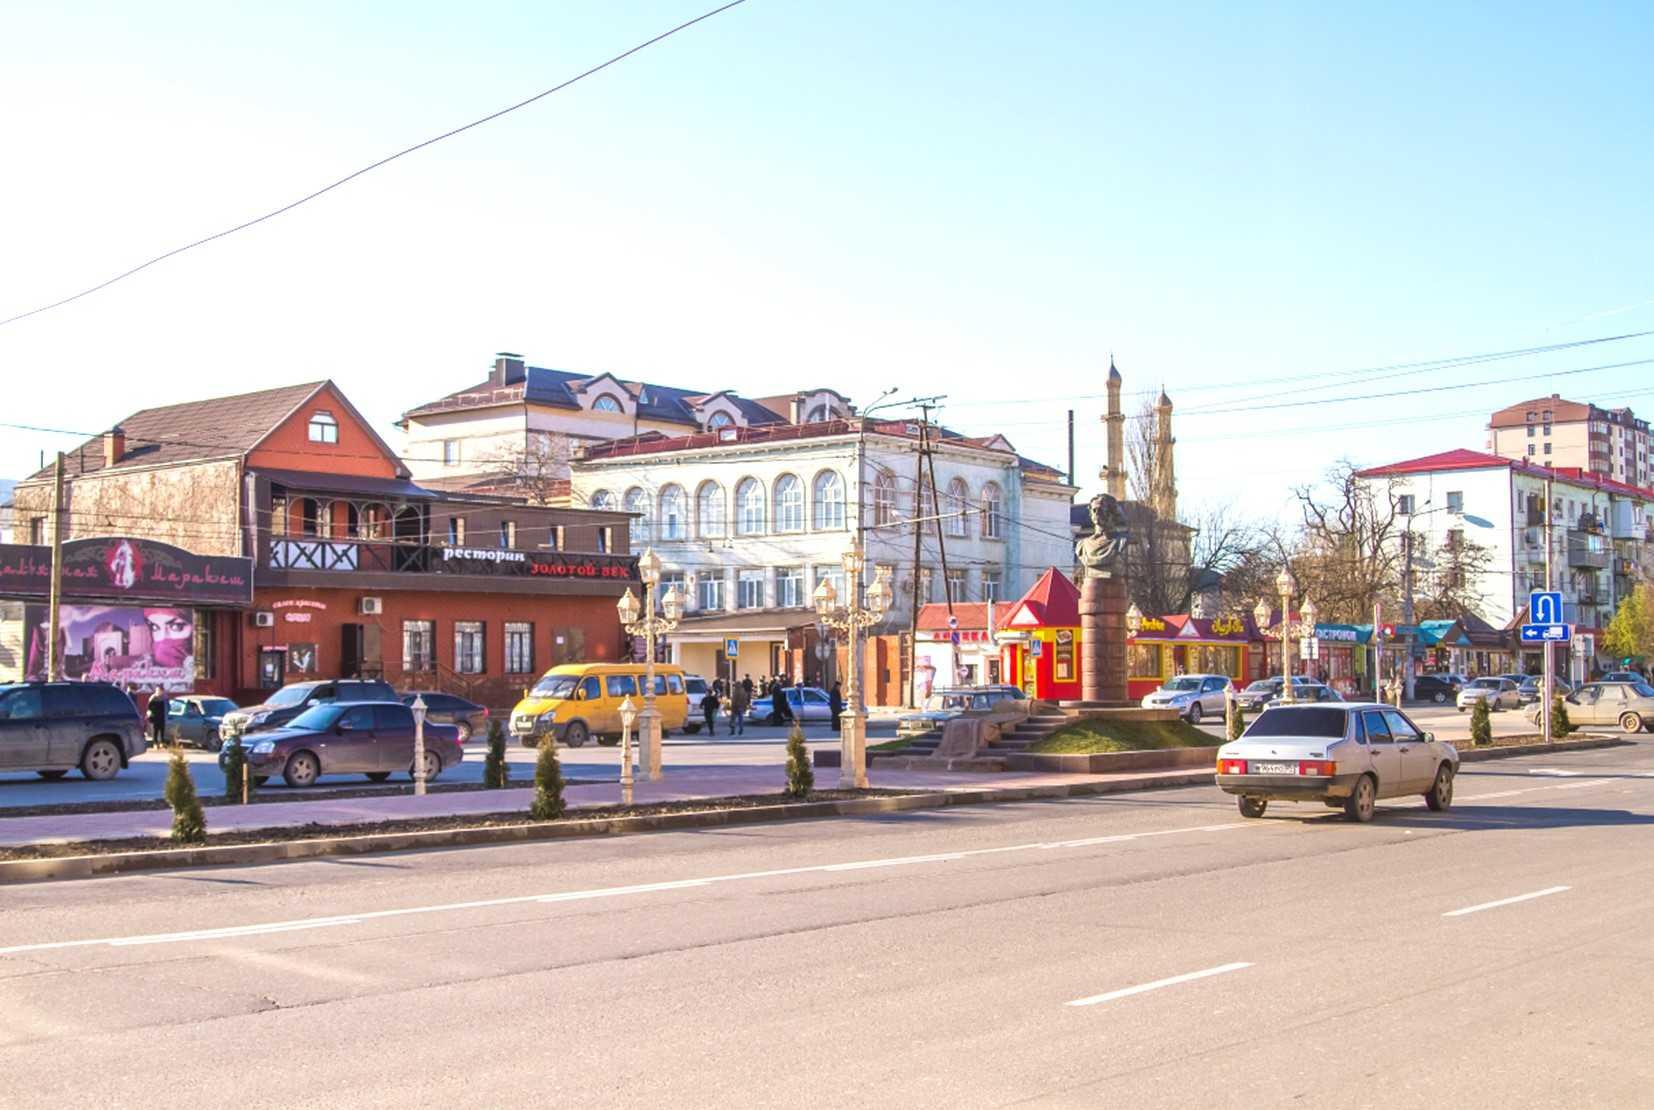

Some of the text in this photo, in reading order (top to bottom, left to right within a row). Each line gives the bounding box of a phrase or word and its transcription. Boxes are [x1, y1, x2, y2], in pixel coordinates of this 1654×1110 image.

[443, 548, 526, 563] ресторан
[531, 561, 630, 578] ЗОЛОТОЙ ВЕК
[933, 631, 989, 641] АПЕКА
